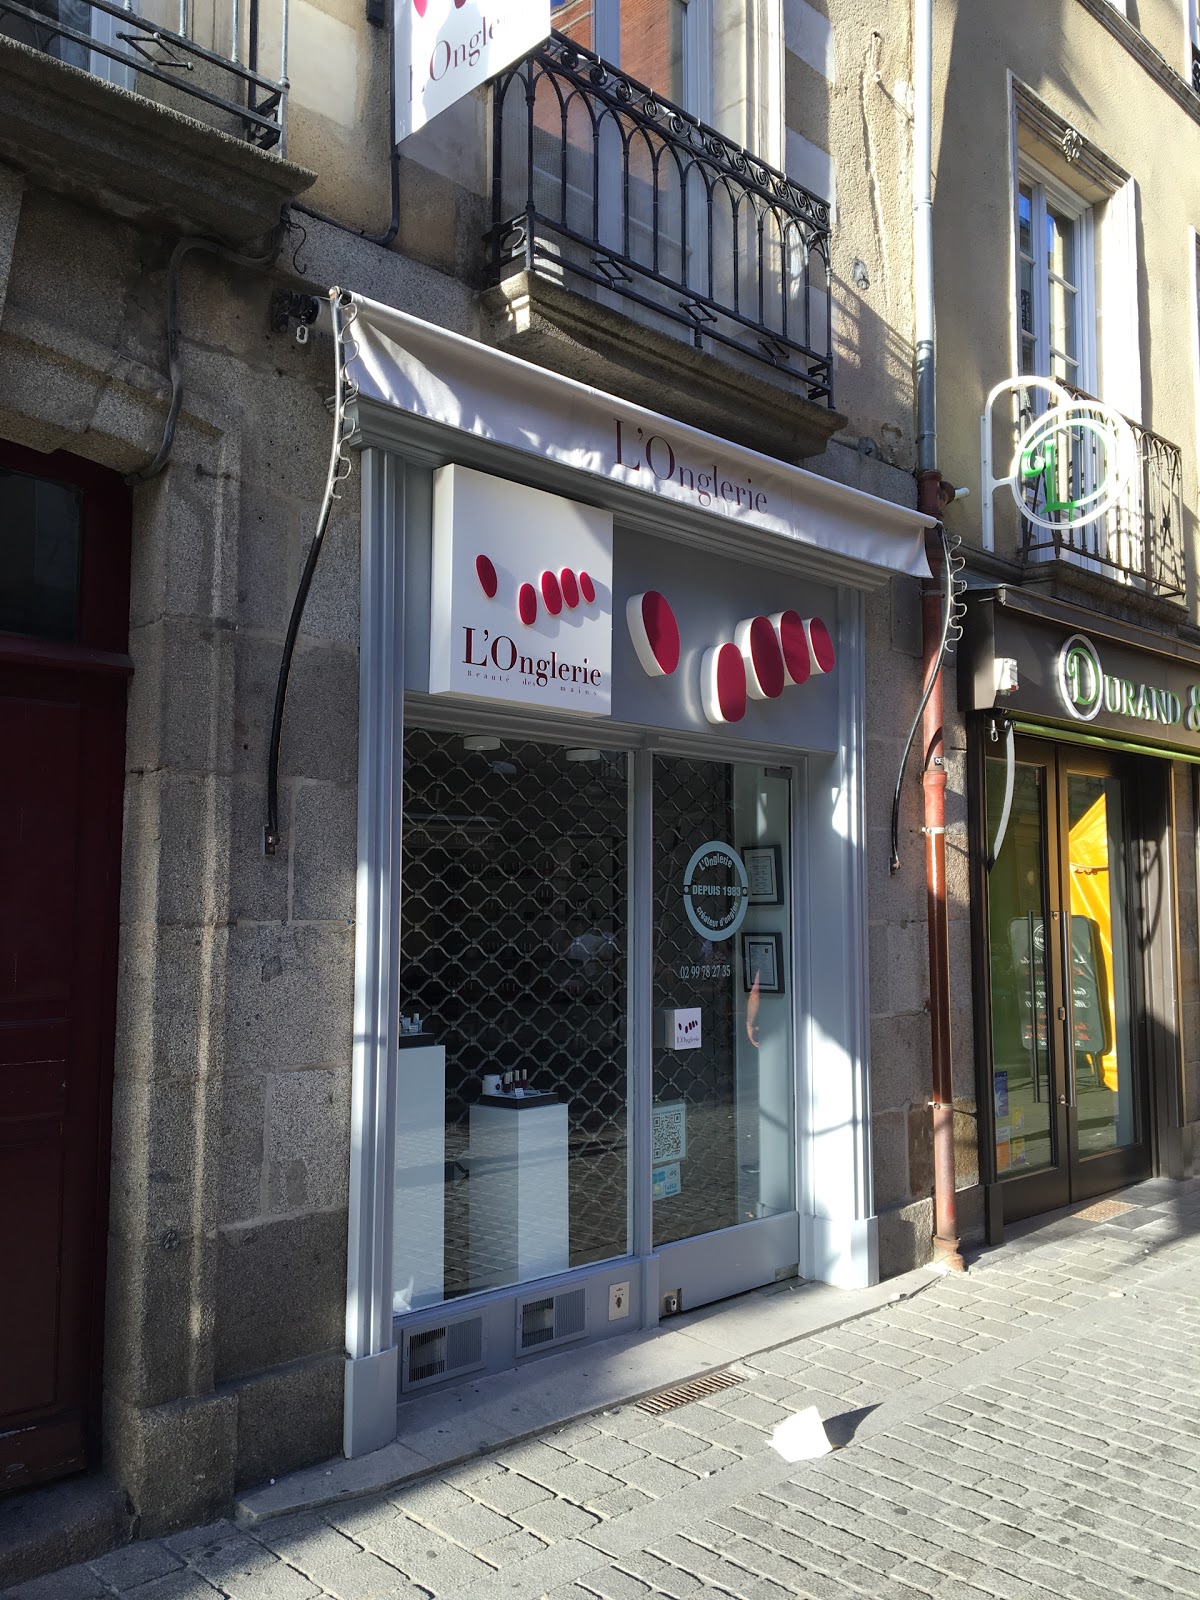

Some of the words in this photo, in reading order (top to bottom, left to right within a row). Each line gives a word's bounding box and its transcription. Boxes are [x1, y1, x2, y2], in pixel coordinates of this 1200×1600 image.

[613, 418, 768, 515] L'Onglerie
[462, 626, 602, 687] L'Onglerie
[467, 669, 511, 683] Beauté
[522, 678, 536, 687] des
[560, 685, 598, 697] mains
[698, 853, 733, 872] L'Onglerie
[692, 884, 721, 896] DEPUIS
[722, 886, 741, 897] 1983
[696, 906, 719, 928] créateur
[719, 901, 739, 927] d'ongles
[680, 966, 690, 979] 02
[691, 965, 701, 979] 99
[701, 965, 711, 978] 78
[712, 965, 721, 978] 27
[721, 964, 731, 977] 35
